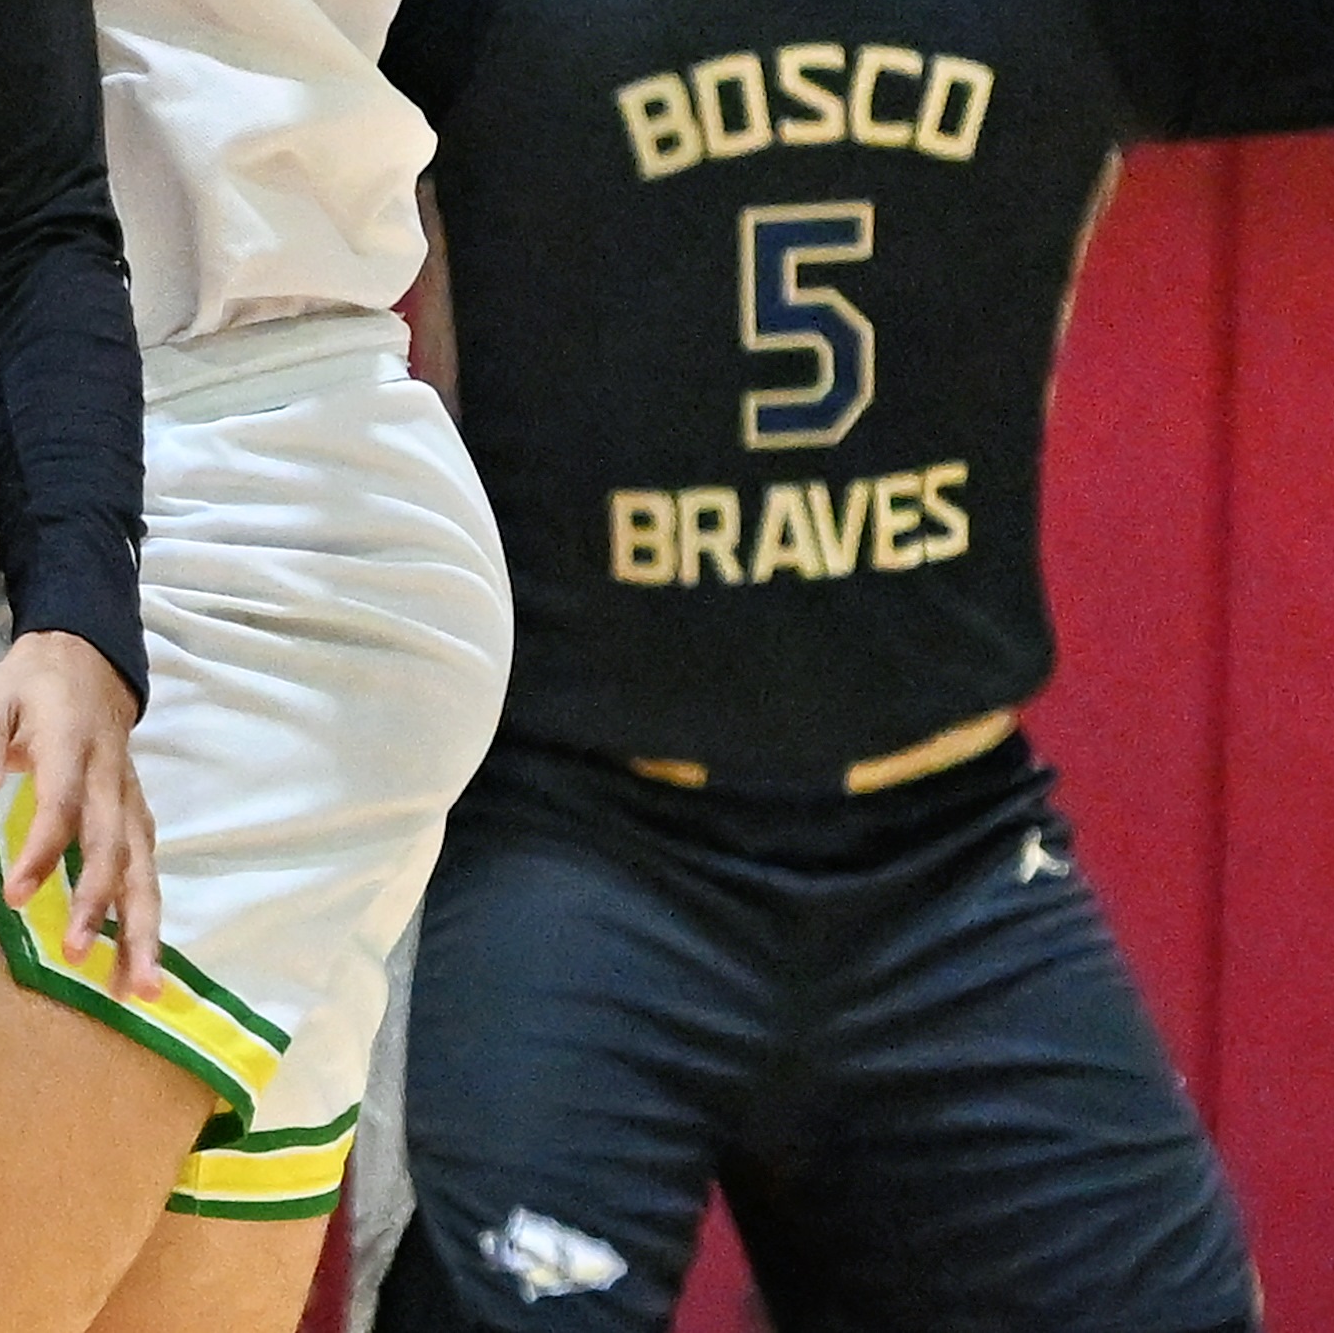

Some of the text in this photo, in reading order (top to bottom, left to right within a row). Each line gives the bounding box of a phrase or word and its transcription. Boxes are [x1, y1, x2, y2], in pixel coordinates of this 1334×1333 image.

[615, 42, 995, 182] BOSCO
[738, 199, 877, 451] 5
[608, 458, 970, 588] BRAVES
